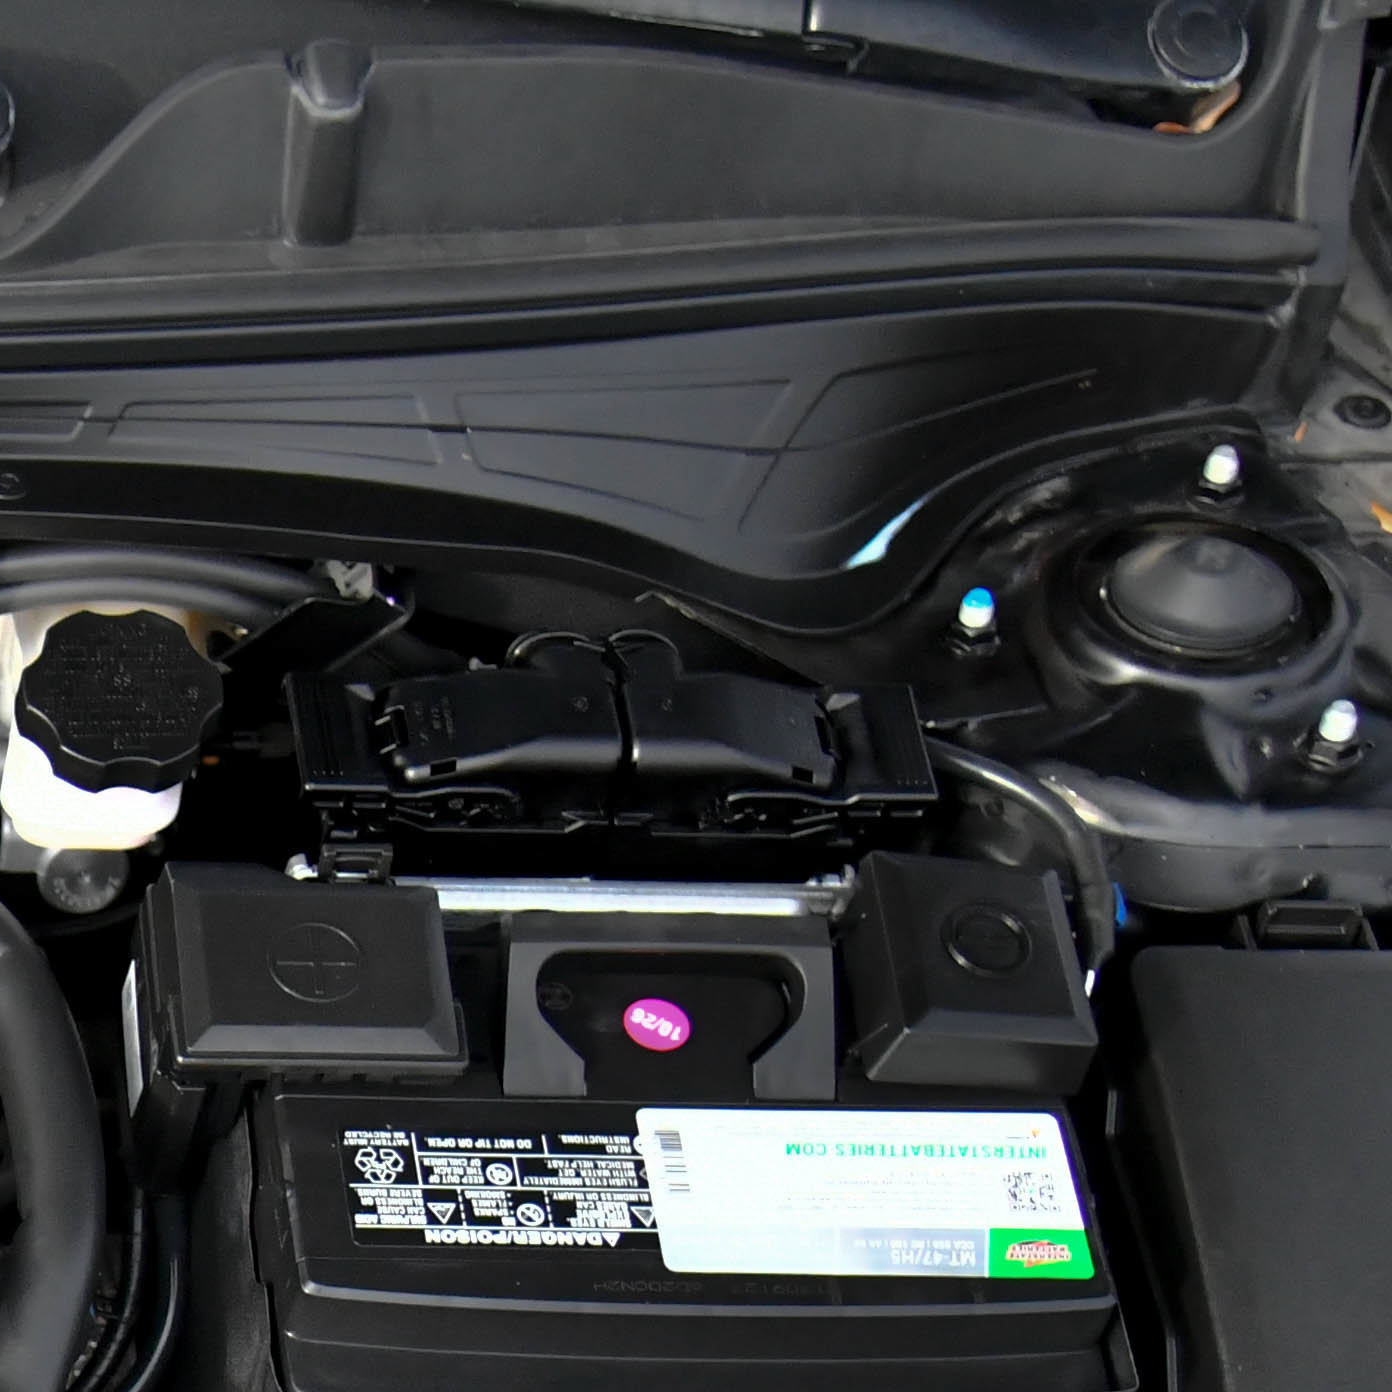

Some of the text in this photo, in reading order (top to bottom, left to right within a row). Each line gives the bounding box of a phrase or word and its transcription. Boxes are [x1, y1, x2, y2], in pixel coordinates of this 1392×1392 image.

[630, 1008, 681, 1041] 10/26
[424, 1138, 455, 1146] OPEN.
[475, 1139, 492, 1147] TIP
[494, 1139, 515, 1147] NOT
[517, 1139, 532, 1148] DO
[558, 1135, 630, 1144] INSTRUCTIONS.
[606, 1145, 632, 1153] READ
[469, 1158, 481, 1166] OF
[544, 1159, 569, 1168] FAST.
[570, 1160, 593, 1168] HELP
[434, 1166, 482, 1175] THE REACH
[611, 1169, 636, 1177] WITH
[428, 1175, 484, 1184] KEEP OUT OF
[523, 1177, 638, 1186] FLUSH EYES IMMEDIATELY
[390, 1189, 422, 1197] SEVERE
[464, 1191, 505, 1199] SMOKING
[550, 1192, 584, 1200] INJURY.
[600, 1193, 649, 1201] BLINDNESS
[361, 1197, 424, 1206] BLINDNESS OR
[471, 1199, 507, 1207] FLAMES
[576, 1201, 596, 1209] CAN
[377, 1206, 425, 1214] CAN CAUSE
[425, 1230, 603, 1246] DANGER/POISON
